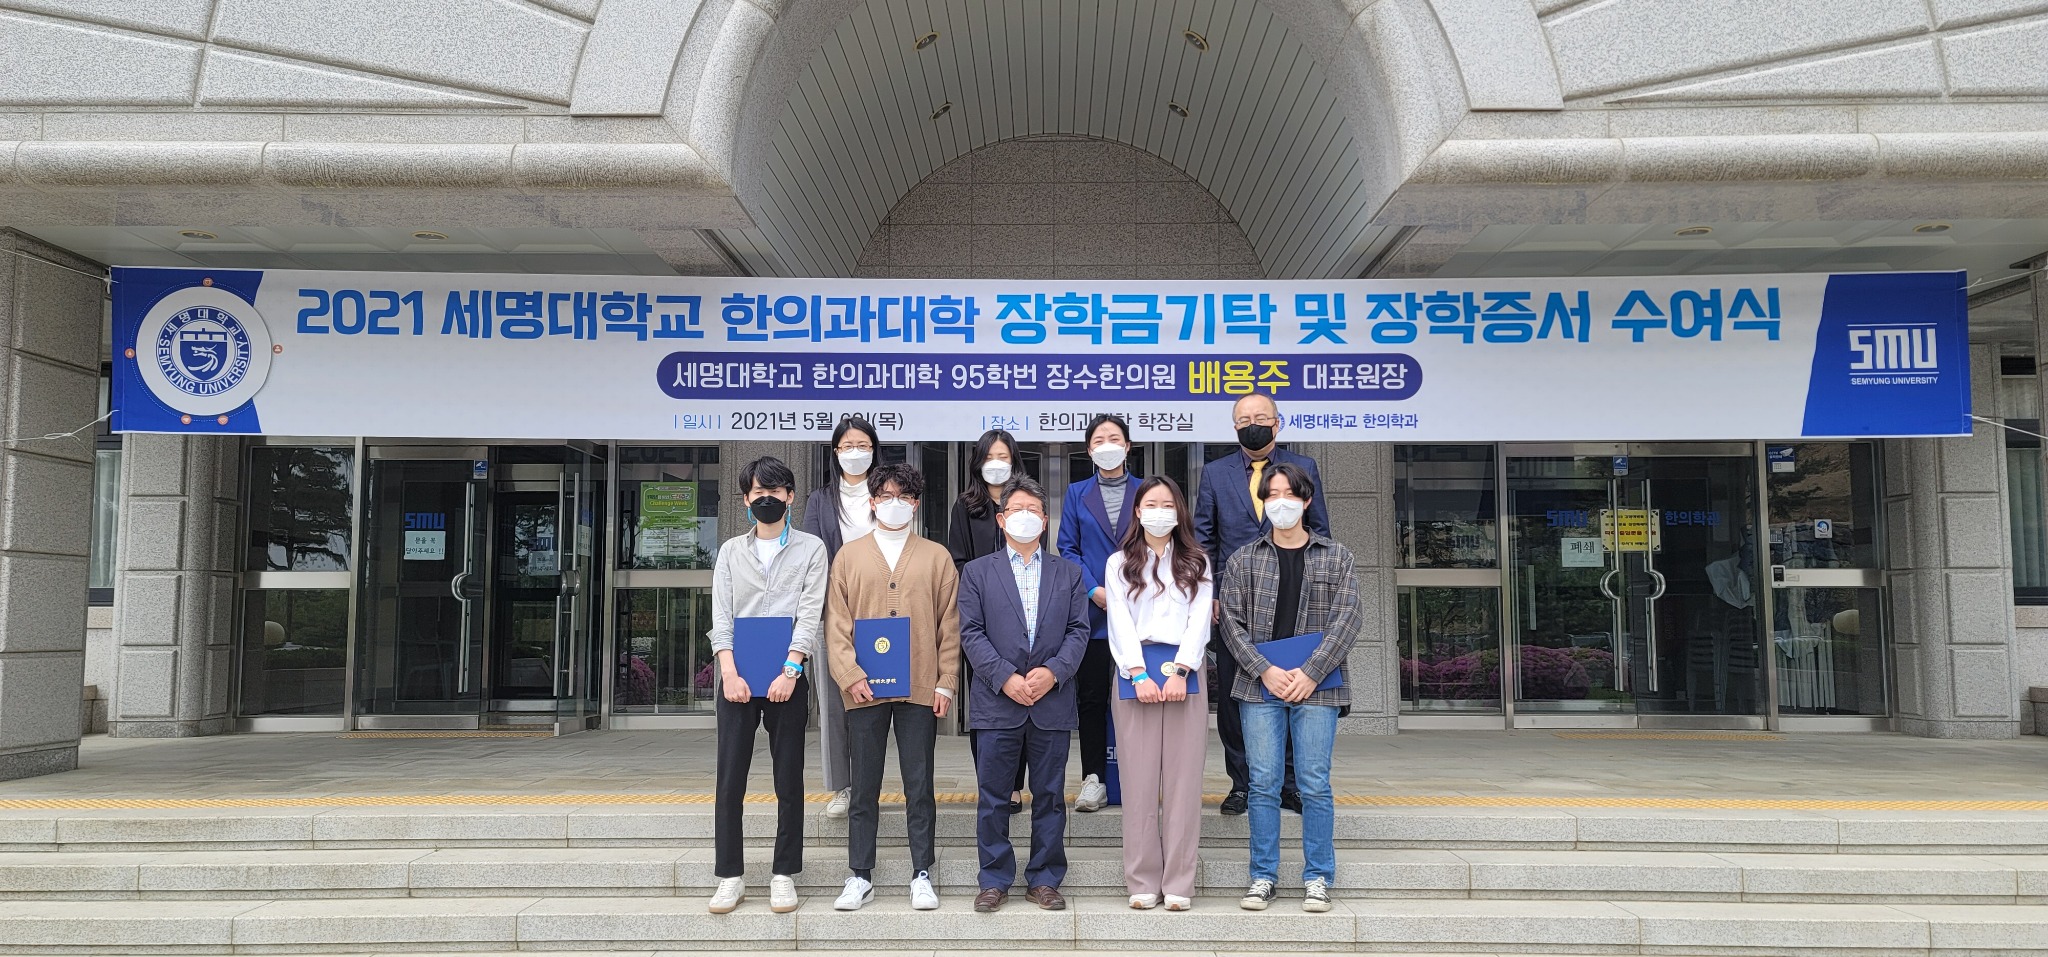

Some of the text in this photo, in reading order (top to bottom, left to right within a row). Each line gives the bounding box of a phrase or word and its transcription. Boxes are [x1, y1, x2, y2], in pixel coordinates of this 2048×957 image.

[164, 307, 242, 338] 세명대학교
[297, 287, 1782, 346] 2021 세명대학교 한의과대학 장학금기탁 및 장학증서 수여식
[1849, 328, 1938, 370] SMU
[158, 338, 249, 395] SEMYUNG UNIVERSITY
[672, 360, 1408, 395] 세명대학교 한의과대학 95학번 장수한의원 배용주 대표원장
[1851, 376, 1938, 386] SEMYUNG UNIVERSITY
[731, 411, 797, 431] 2021년
[803, 411, 833, 431] 5월
[1039, 412, 1132, 431] 한의과
[1138, 412, 1194, 432] 학장실
[1289, 413, 1358, 430] 세명대학교
[1362, 413, 1419, 430] 한의학과
[404, 512, 446, 529] SMU
[1546, 510, 1588, 528] SMU
[1664, 510, 1722, 528] 한의학관
[1570, 541, 1596, 554] 폐쇄
